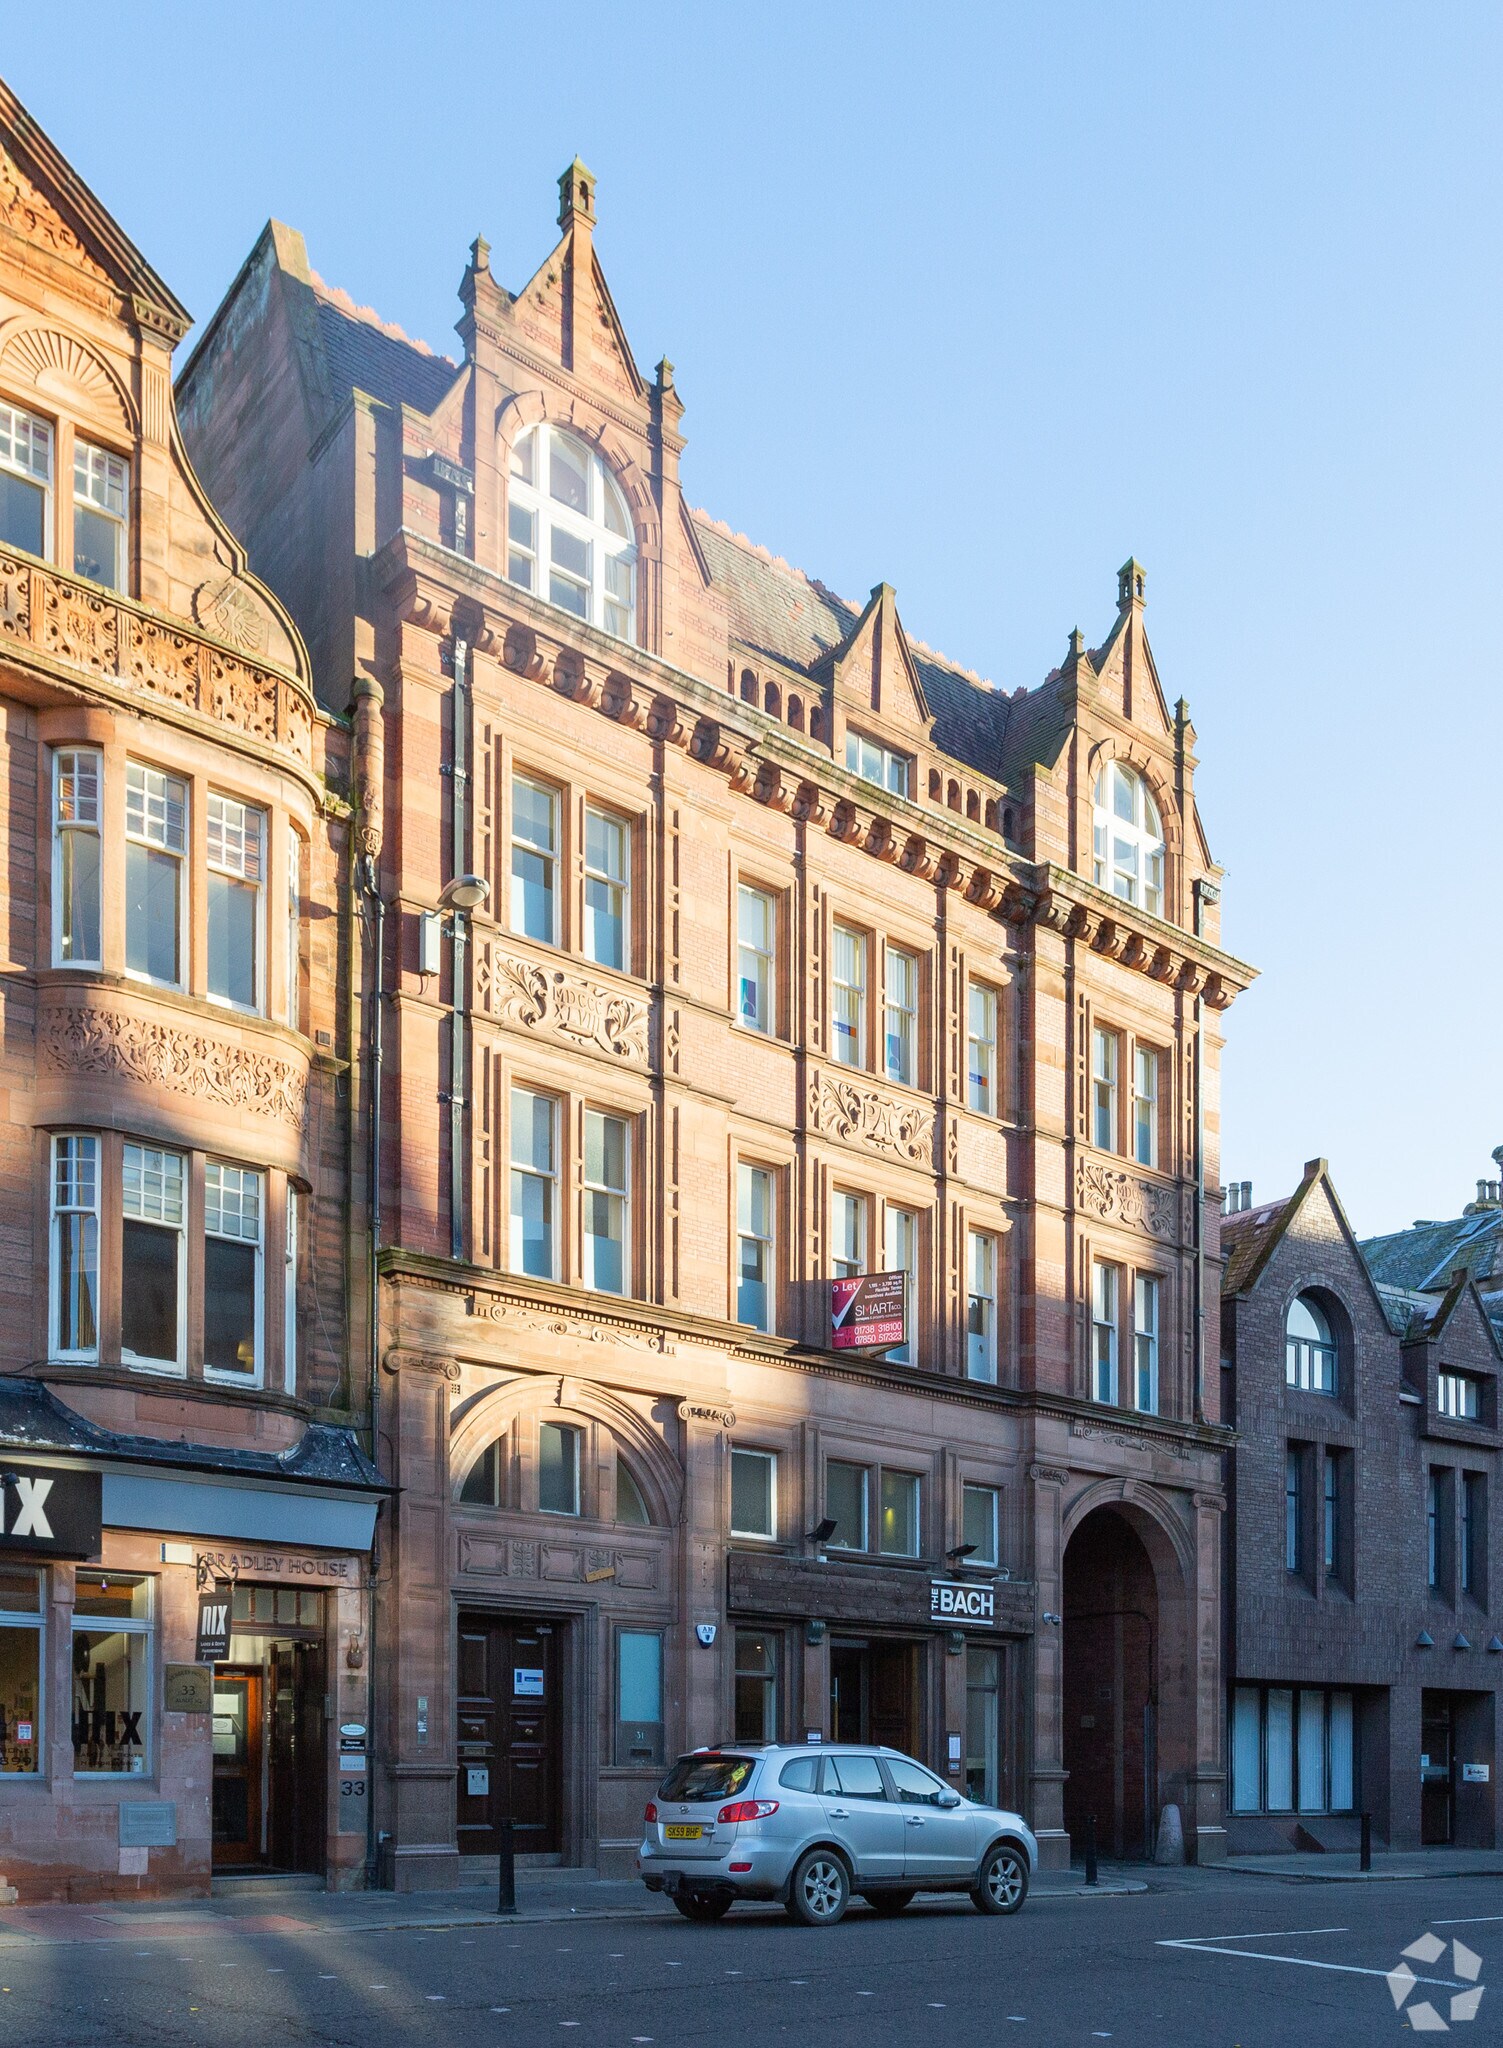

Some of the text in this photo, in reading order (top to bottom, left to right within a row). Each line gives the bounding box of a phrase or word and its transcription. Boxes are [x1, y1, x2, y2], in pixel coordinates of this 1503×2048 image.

[553, 986, 600, 1015] MDCCC
[554, 1004, 599, 1032] XLVIII
[863, 1103, 898, 1137] PAC
[842, 1282, 857, 1291] Let
[855, 1302, 893, 1316] SMART
[854, 1325, 875, 1335] 01738
[878, 1322, 902, 1332] 318100
[855, 1335, 876, 1345] 07850
[878, 1332, 902, 1342] 517323
[206, 1552, 348, 1578] BRADLEY HOUSE
[941, 1588, 994, 1616] BACH
[181, 1685, 196, 1696] 33
[637, 1731, 644, 1739] 31
[341, 1781, 365, 1796] 33
[667, 1826, 700, 1837] SK59 BHF
